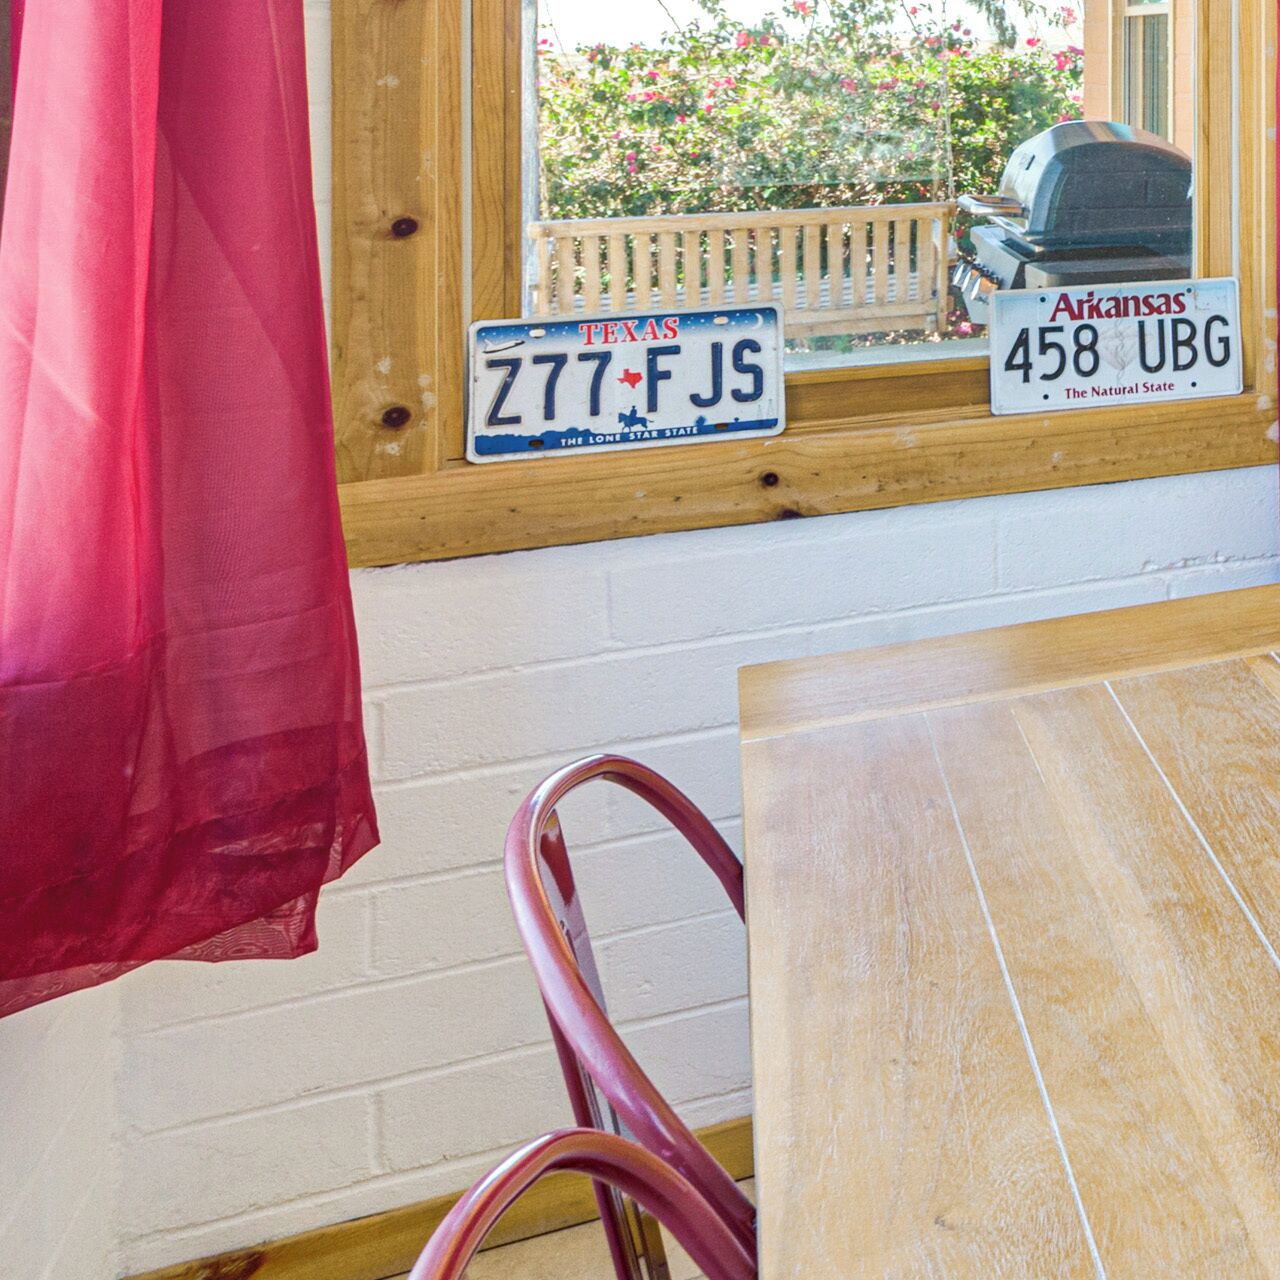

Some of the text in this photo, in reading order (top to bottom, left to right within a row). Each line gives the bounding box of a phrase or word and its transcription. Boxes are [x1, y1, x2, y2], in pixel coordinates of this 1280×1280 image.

[1049, 290, 1186, 322] Arkansas
[579, 317, 679, 346] TEXAS
[1004, 314, 1231, 384] 458 UBG
[487, 351, 612, 426] Z77
[1064, 381, 1175, 399] The Natural State
[560, 426, 698, 447] THE LONE STAR STATE
